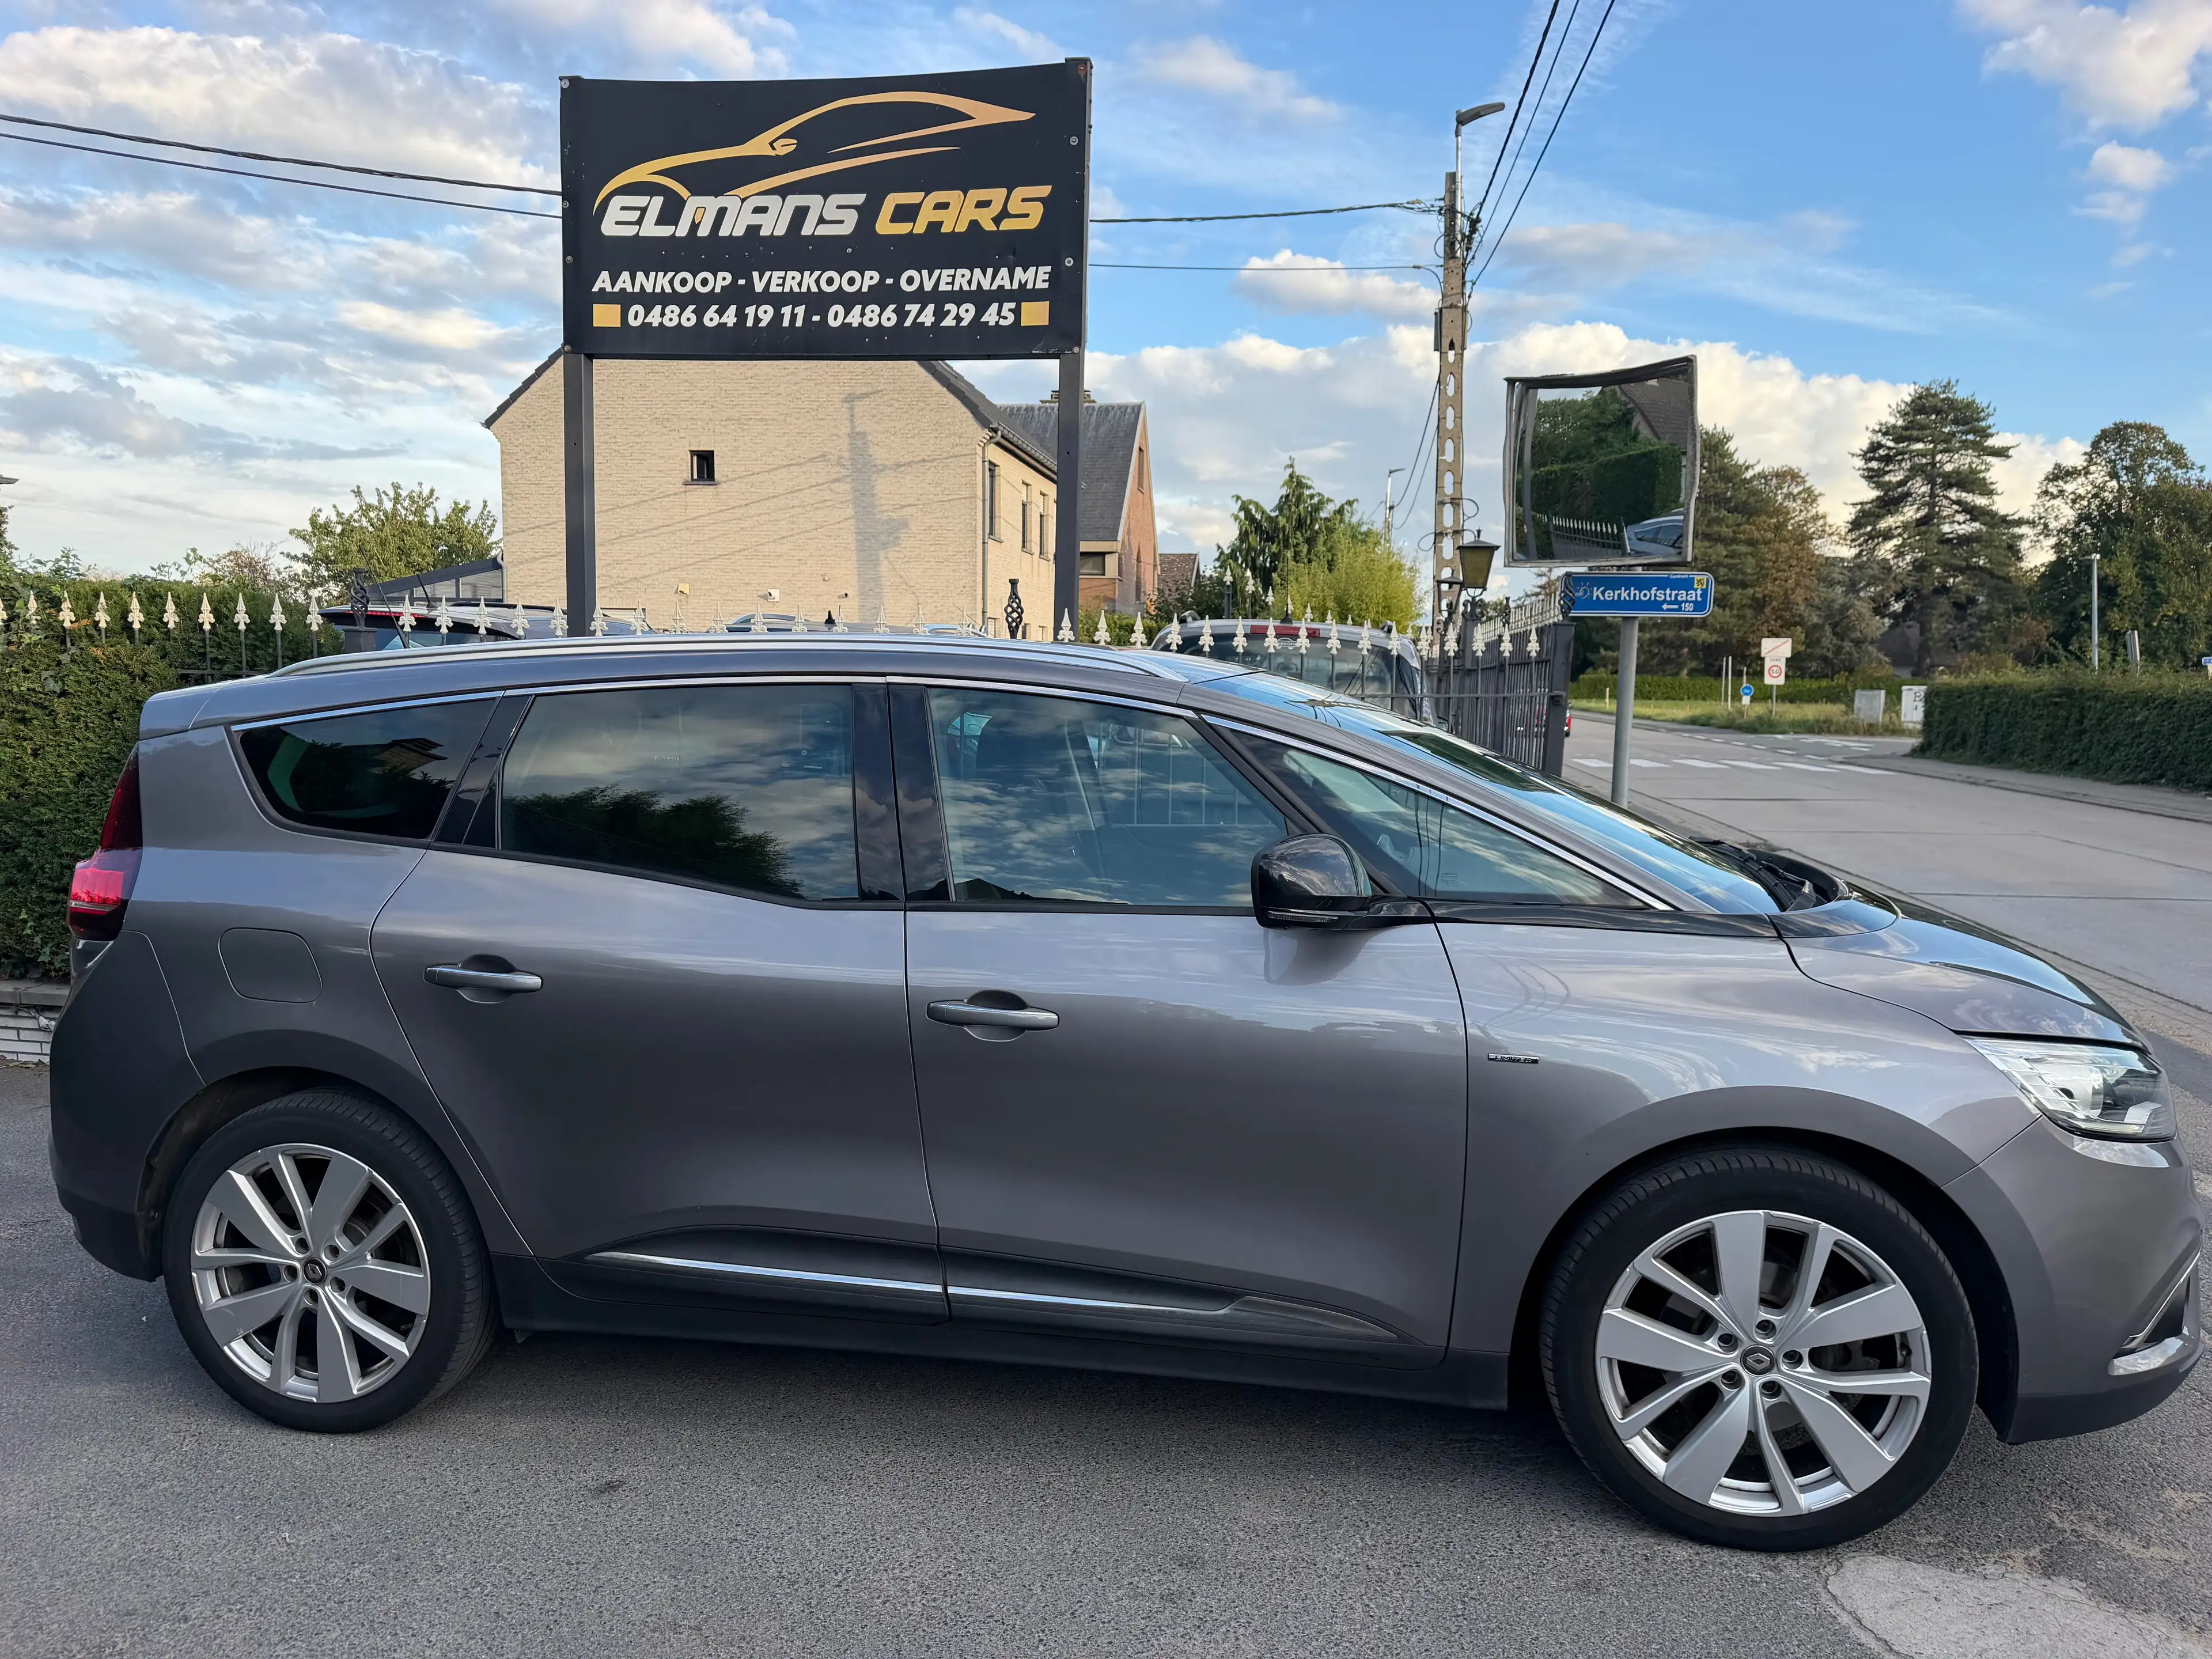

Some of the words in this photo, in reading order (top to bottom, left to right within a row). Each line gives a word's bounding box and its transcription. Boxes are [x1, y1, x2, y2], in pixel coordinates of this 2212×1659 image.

[601, 194, 866, 237] ELMANS
[875, 185, 1052, 234] CARS
[591, 270, 732, 293] AANKOOP
[752, 270, 880, 293] VERKOOP
[900, 266, 1052, 292] OVERNAME
[627, 304, 697, 327] 0486
[703, 305, 737, 327] 64
[744, 304, 774, 327] 19
[781, 304, 806, 327] 11
[827, 304, 897, 327] 0486
[903, 304, 935, 327] 74
[940, 302, 976, 327] 29
[980, 302, 1016, 326] 45
[1593, 586, 1702, 601] Kerkhofstraat
[1681, 603, 1694, 611] 150
